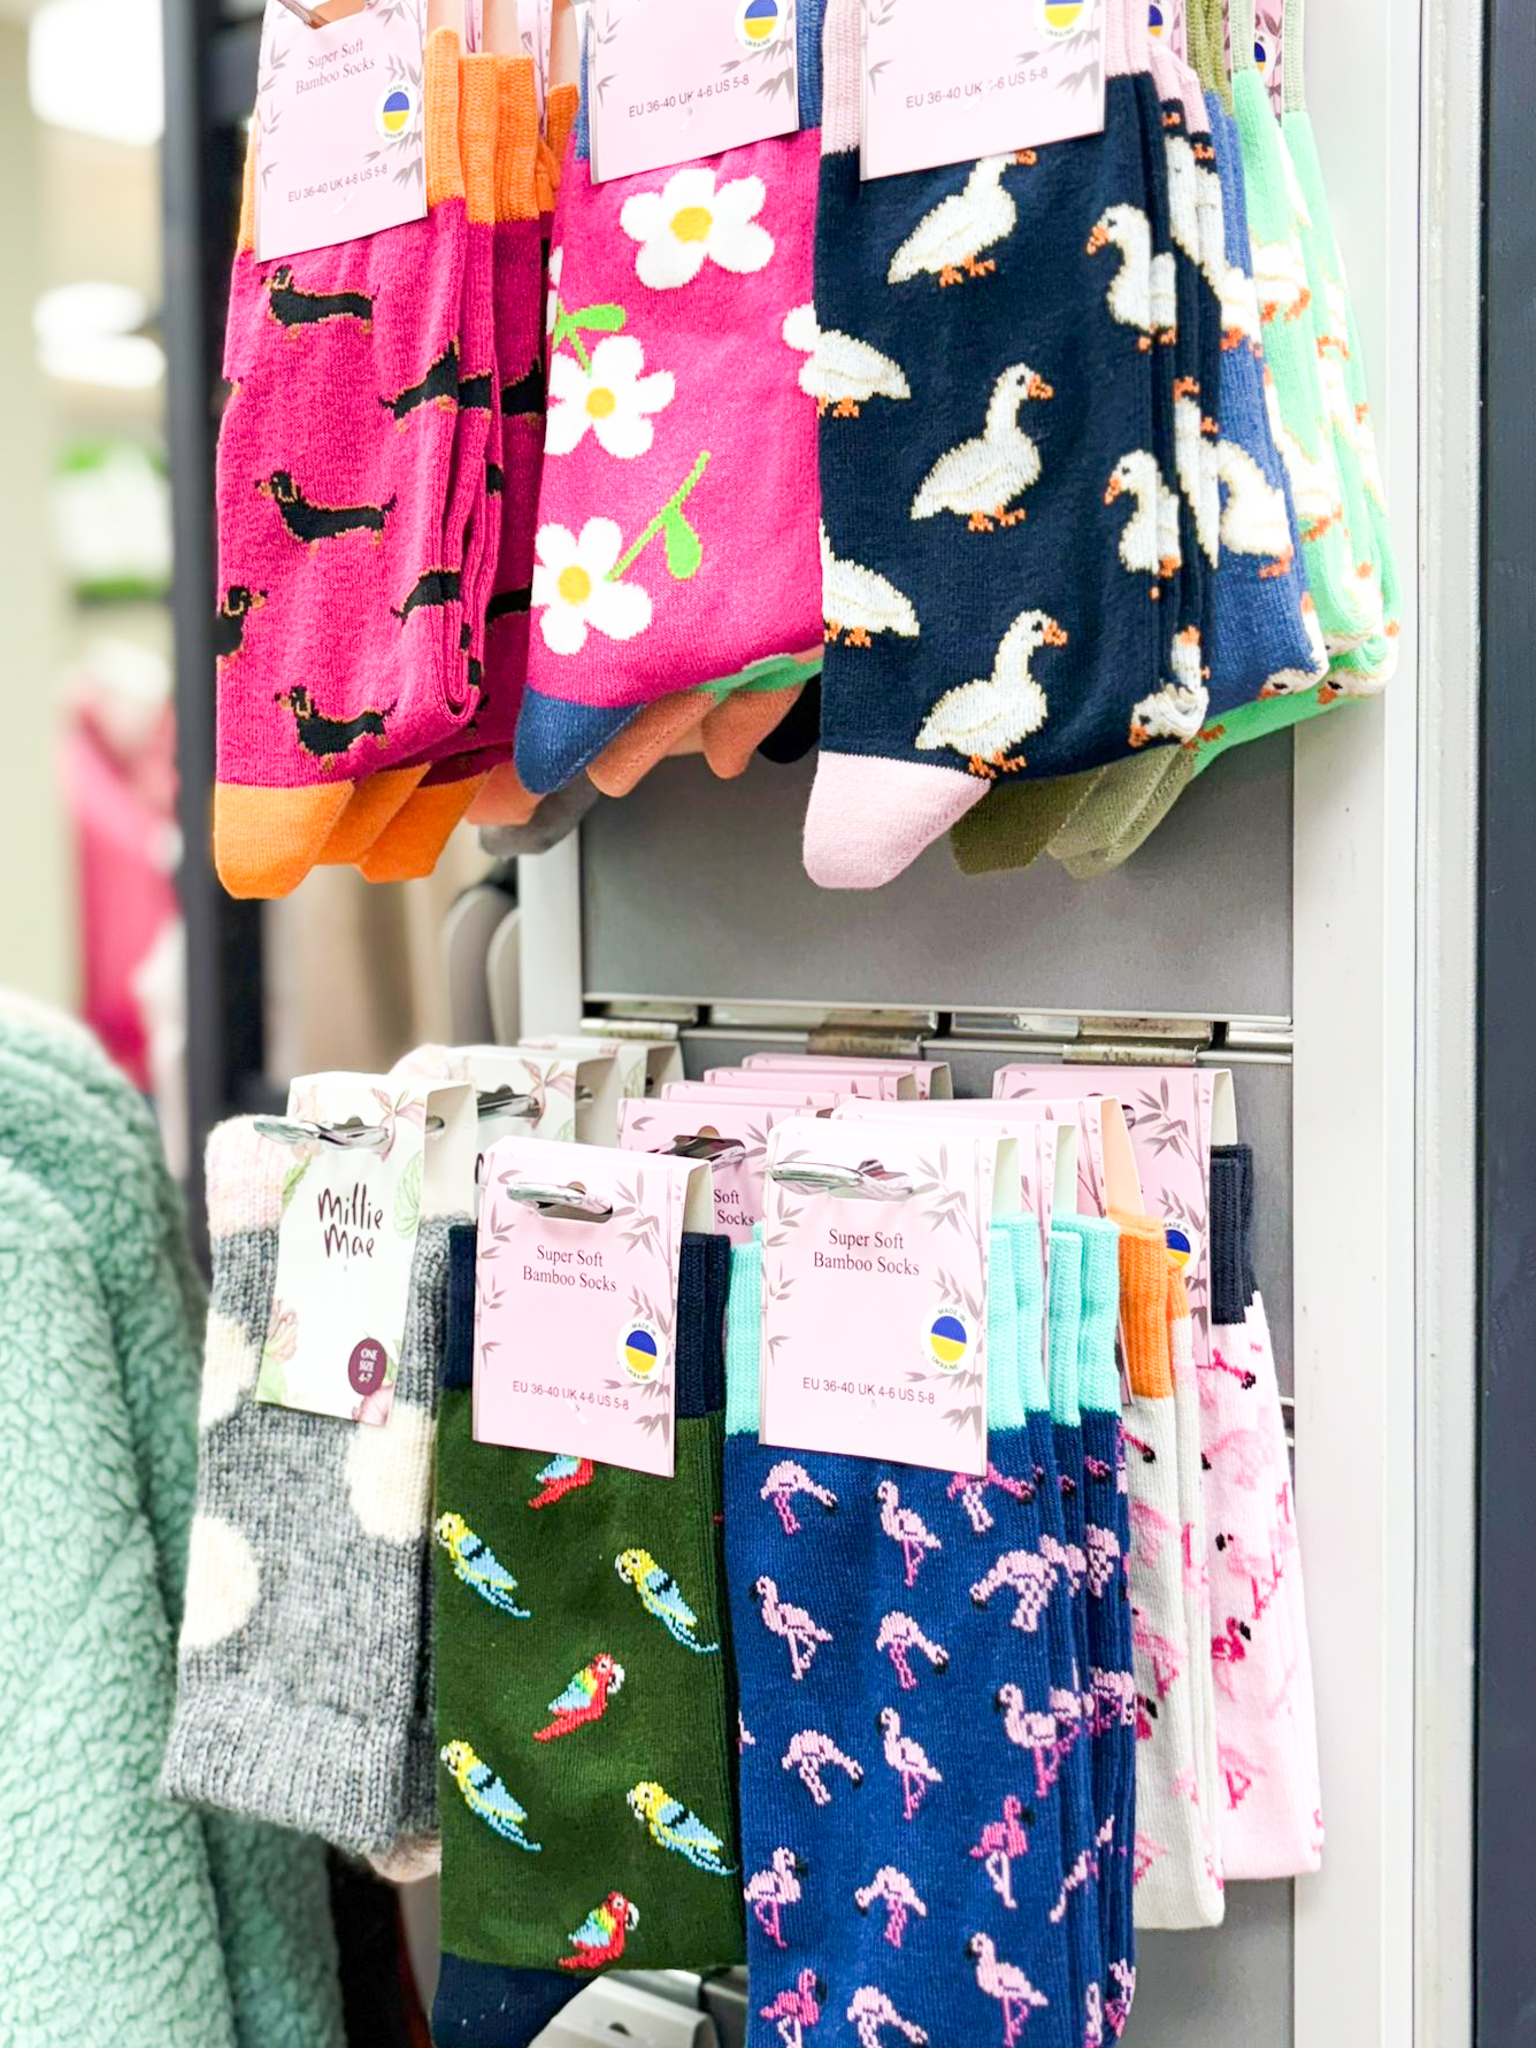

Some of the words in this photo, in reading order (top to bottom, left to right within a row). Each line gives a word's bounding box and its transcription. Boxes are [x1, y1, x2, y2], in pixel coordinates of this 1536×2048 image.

[307, 50, 338, 70] Super
[341, 37, 363, 58] Soft
[295, 71, 340, 94] Bamboo
[342, 57, 375, 78] Socks
[906, 94, 924, 109] EU
[926, 86, 961, 104] 36-40
[964, 80, 982, 97] UK
[1008, 71, 1026, 87] US
[1029, 66, 1048, 81] 5-8
[628, 103, 644, 118] EU
[646, 95, 676, 113] 36-40
[678, 90, 694, 105] UK
[697, 84, 713, 98] 4-6
[715, 78, 730, 93] US
[732, 74, 749, 89] 5-8
[288, 190, 301, 202] EU
[303, 182, 328, 199] 36-40
[329, 177, 343, 191] UK
[345, 173, 358, 185] 4-6
[360, 168, 372, 181] US
[374, 162, 387, 177] 5-8
[317, 1182, 383, 1230] Millie
[713, 1188, 740, 1205] Soft
[716, 1209, 755, 1227] Socks
[324, 1223, 375, 1259] Mae
[828, 1228, 870, 1250] Super
[874, 1231, 904, 1250] Soft
[536, 1244, 573, 1266] Super
[576, 1249, 603, 1268] Soft
[814, 1251, 873, 1272] Bamboo
[876, 1255, 920, 1276] Socks
[523, 1264, 576, 1286] Bamboo
[579, 1272, 617, 1293] Socks
[359, 1359, 375, 1371] SIZE
[360, 1347, 379, 1361] ONE
[513, 1380, 528, 1394] EU
[530, 1383, 560, 1398] 36-40
[562, 1387, 577, 1400] UK
[579, 1391, 595, 1404] 4-6
[597, 1394, 612, 1407] US
[613, 1397, 630, 1411] 5-8
[802, 1376, 821, 1391] EU
[822, 1379, 855, 1394] 36-40
[858, 1382, 876, 1396] UK
[877, 1385, 896, 1400] 4-6
[898, 1388, 915, 1402] US
[917, 1390, 936, 1405] 5-8
